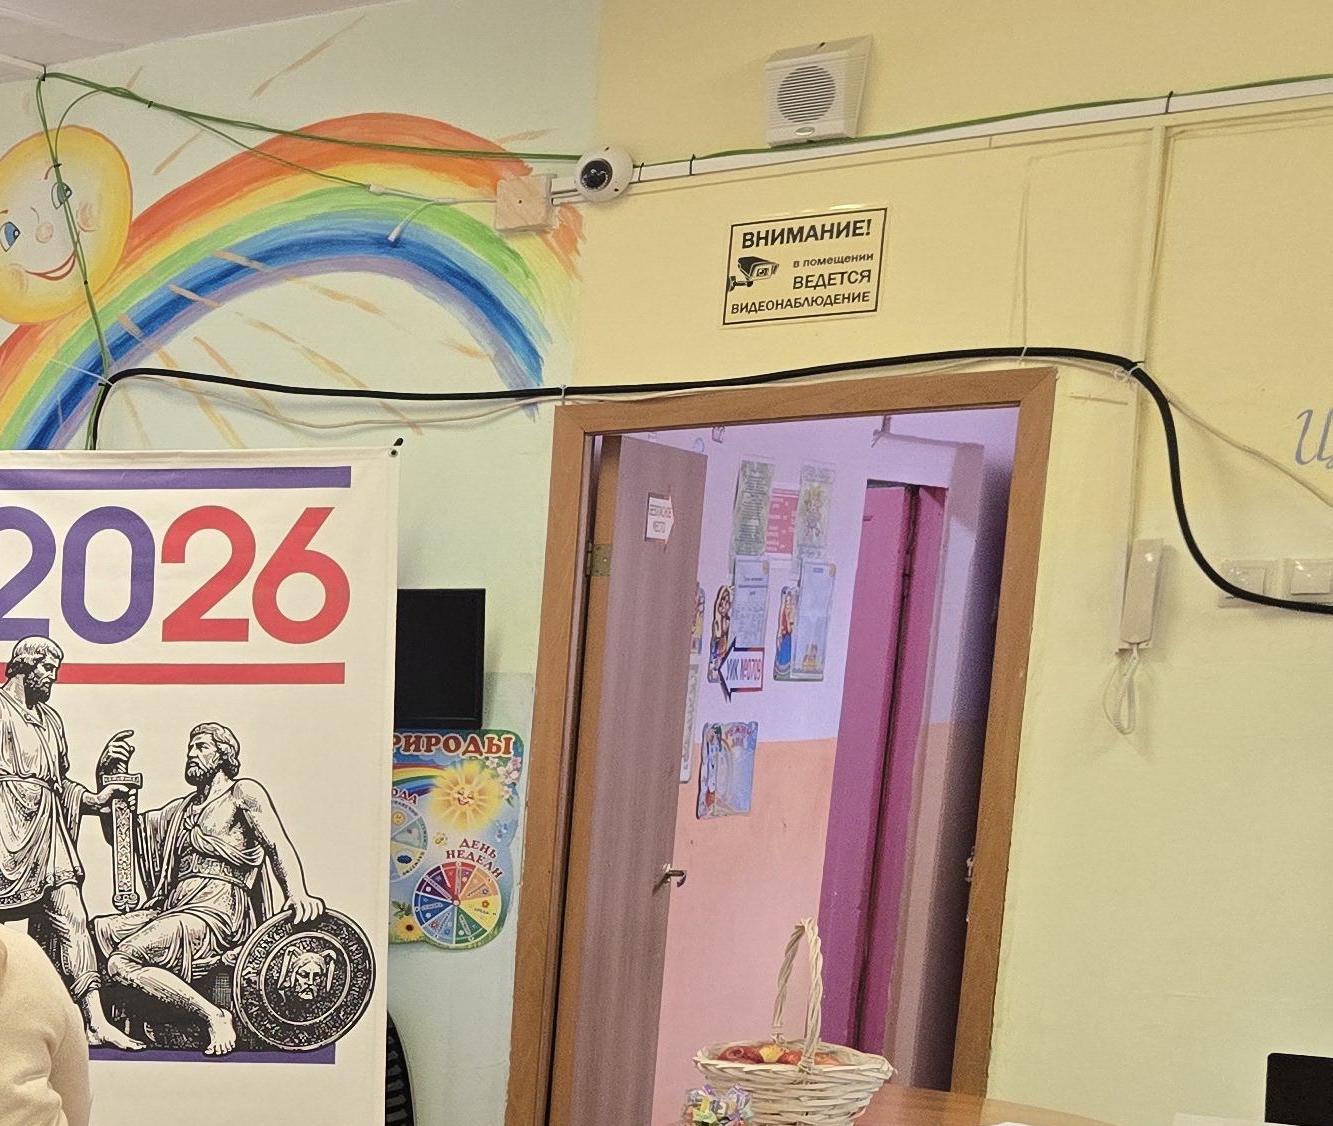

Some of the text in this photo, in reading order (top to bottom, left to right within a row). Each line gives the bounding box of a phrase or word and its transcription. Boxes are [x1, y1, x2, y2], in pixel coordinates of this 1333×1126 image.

[741, 218, 872, 249] ВНИМАНИЕ!
[792, 253, 874, 268] в помещении
[793, 269, 872, 290] ВЕДЕТСЯ
[731, 291, 871, 314] ВИДЕОНАБЛЮДЕНИЕ
[392, 788, 418, 805] ОДА
[459, 838, 498, 859] ДЕНЬ
